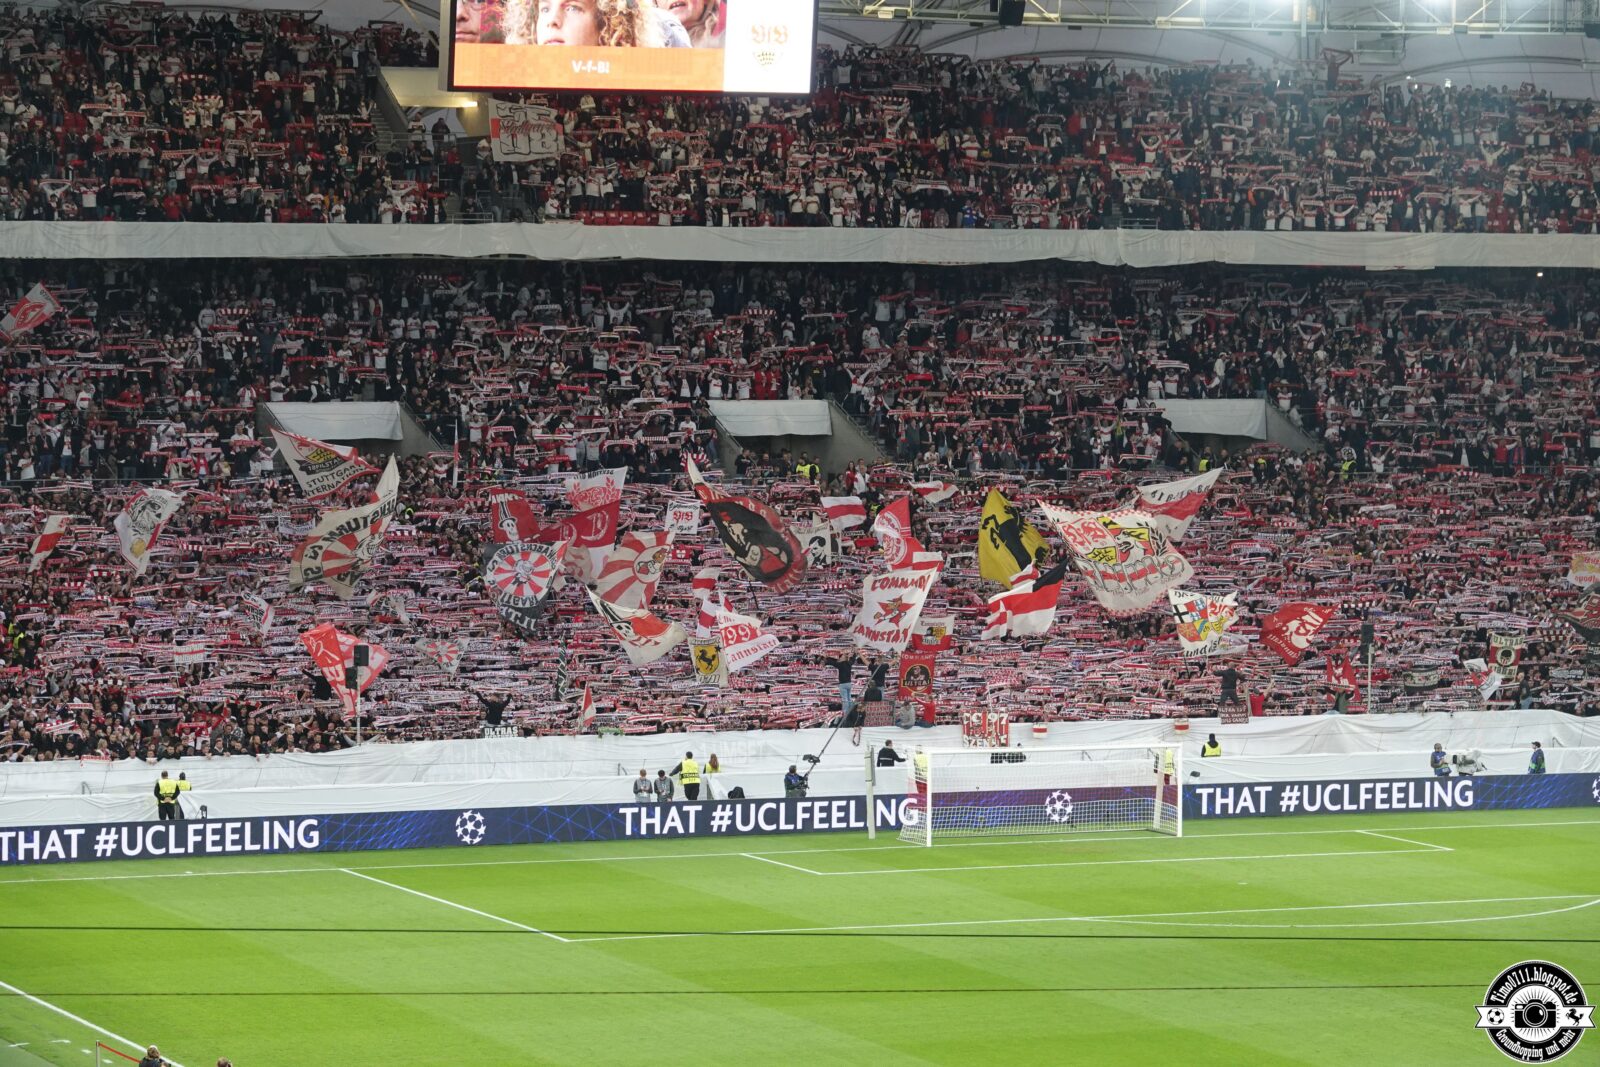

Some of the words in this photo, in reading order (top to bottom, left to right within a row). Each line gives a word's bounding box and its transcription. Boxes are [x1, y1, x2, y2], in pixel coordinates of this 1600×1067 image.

[484, 726, 518, 736] ULTRAS
[1196, 785, 1272, 815] THAT
[1280, 780, 1474, 812] #UCLFEELING
[619, 805, 702, 836] THAT
[711, 798, 919, 832] #UCLFEELNG
[0, 828, 85, 862] THAT
[94, 818, 320, 857] #UCLFEELING
